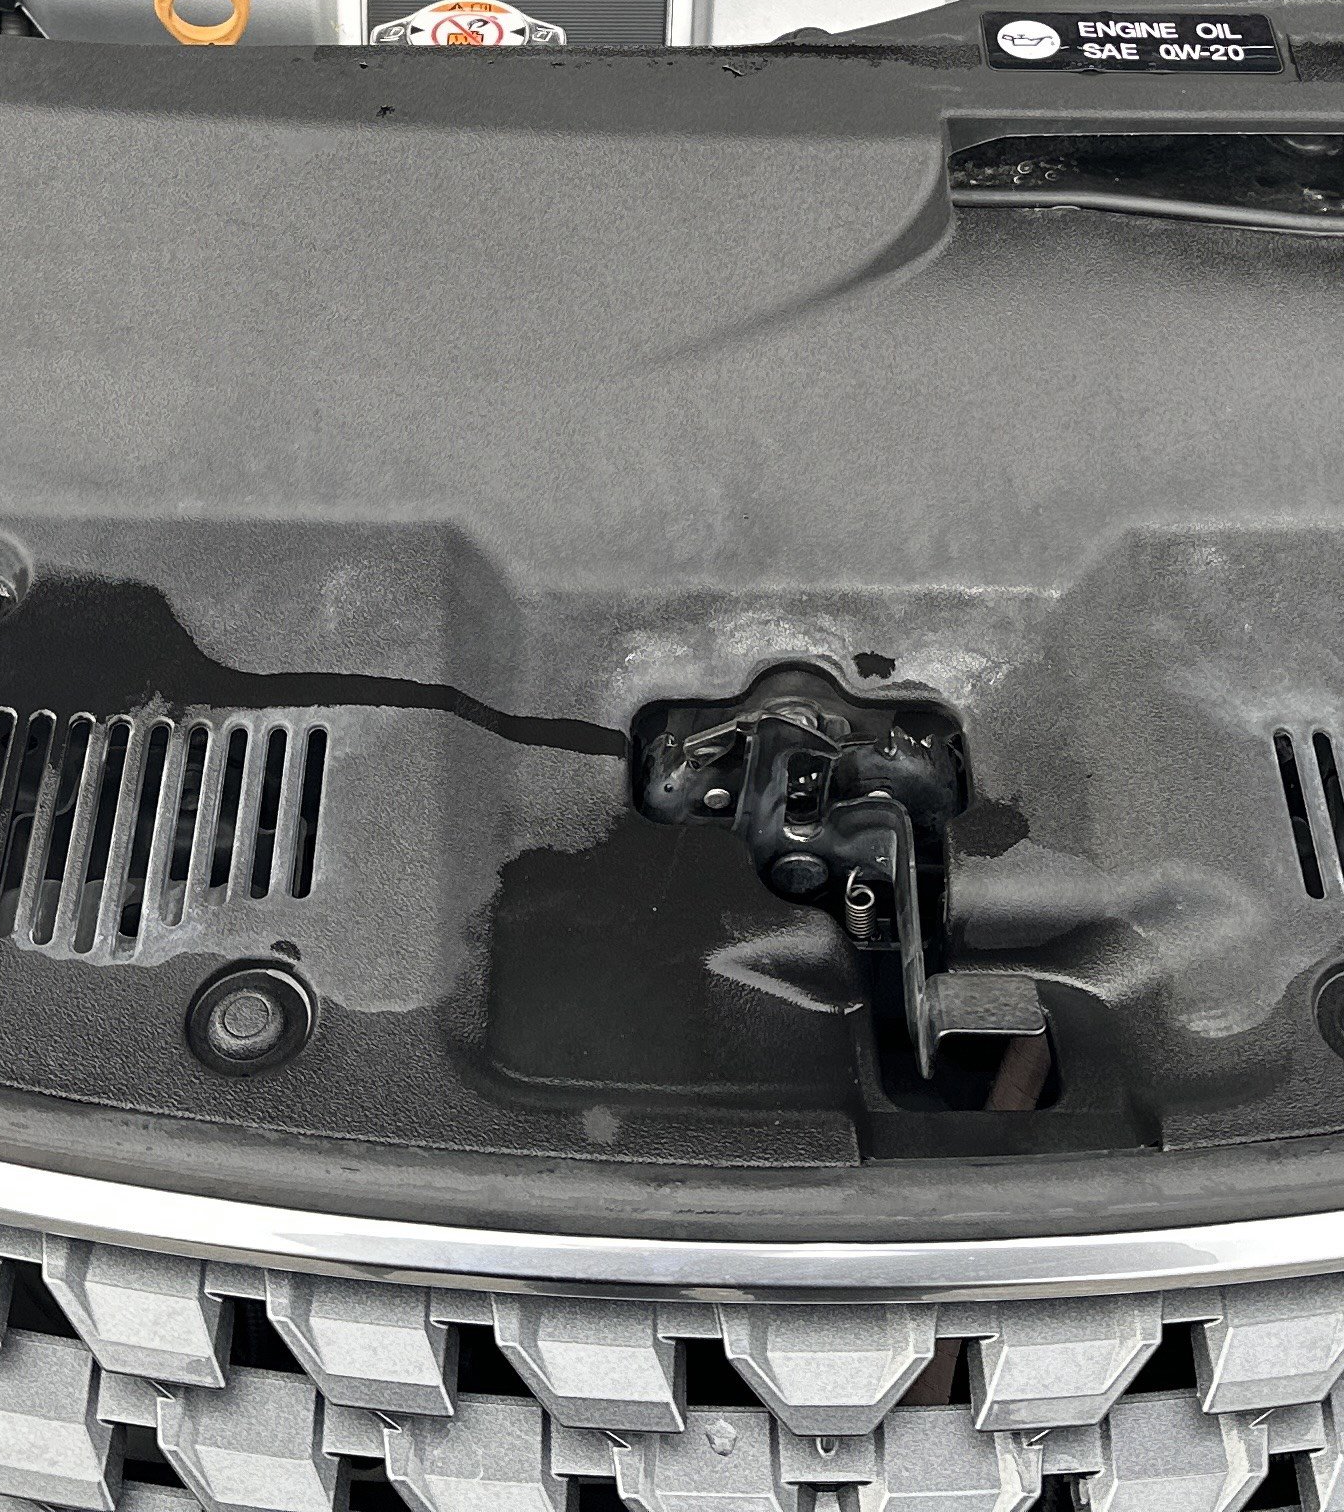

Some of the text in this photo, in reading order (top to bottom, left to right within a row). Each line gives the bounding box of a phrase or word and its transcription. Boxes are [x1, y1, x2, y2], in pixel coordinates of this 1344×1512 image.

[1077, 21, 1243, 40] ENGINE OIL
[1082, 44, 1245, 61] SAE 0W-20
